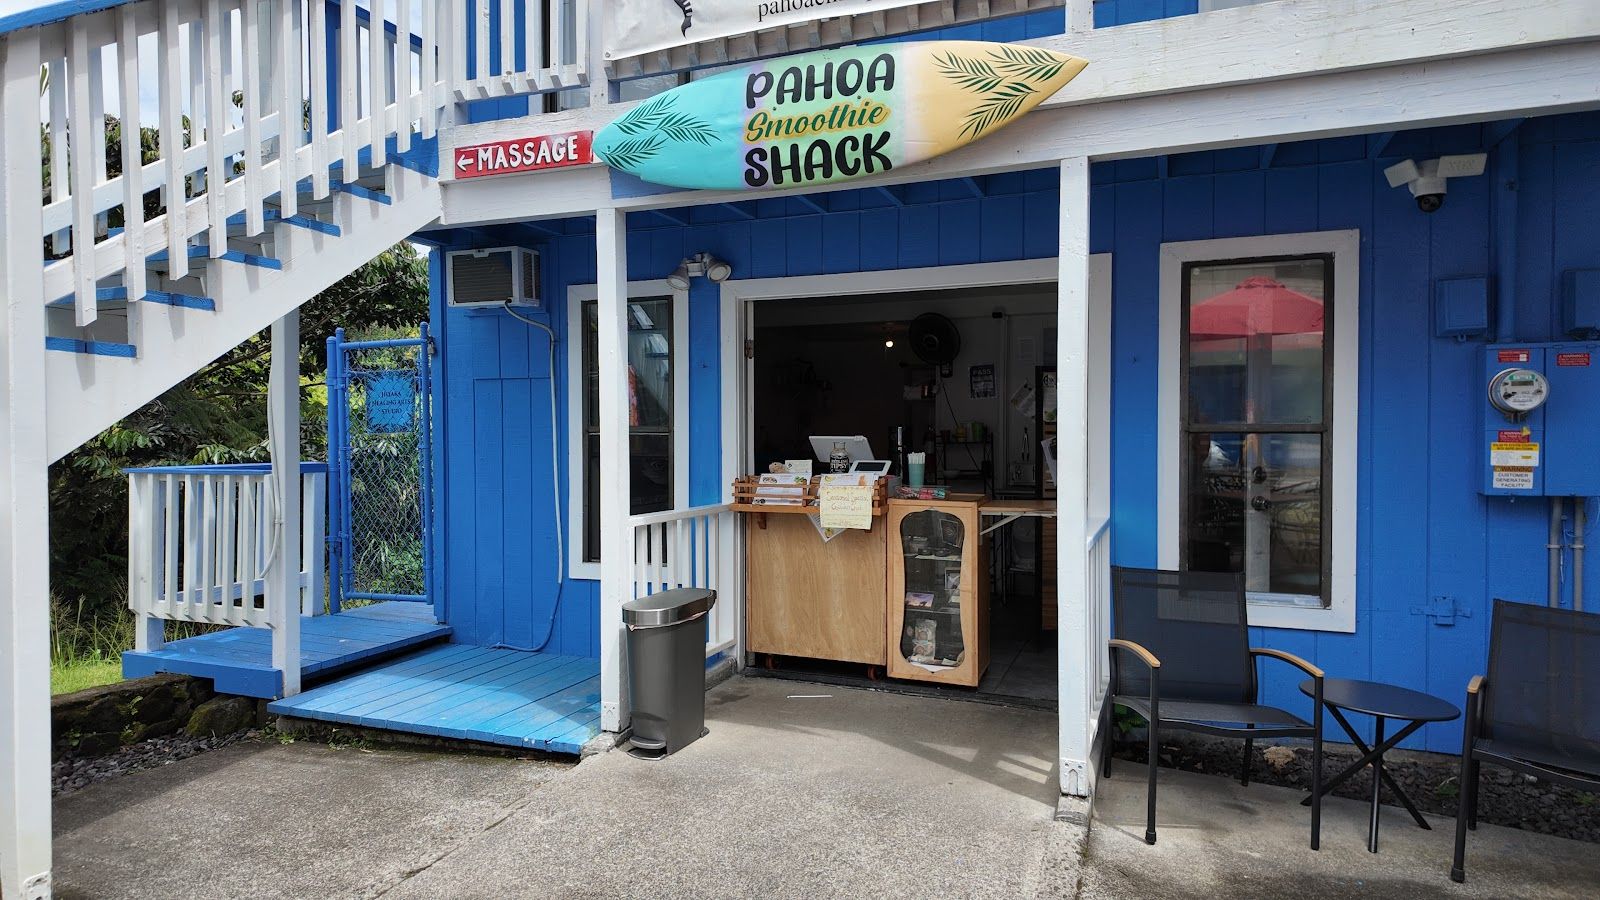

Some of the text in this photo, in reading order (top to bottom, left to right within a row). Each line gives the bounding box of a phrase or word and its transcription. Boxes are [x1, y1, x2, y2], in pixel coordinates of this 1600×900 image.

[745, 53, 896, 109] PAHOA
[745, 101, 889, 142] Smoothie
[477, 135, 578, 171] MASSAGE
[744, 131, 893, 187] SHACK
